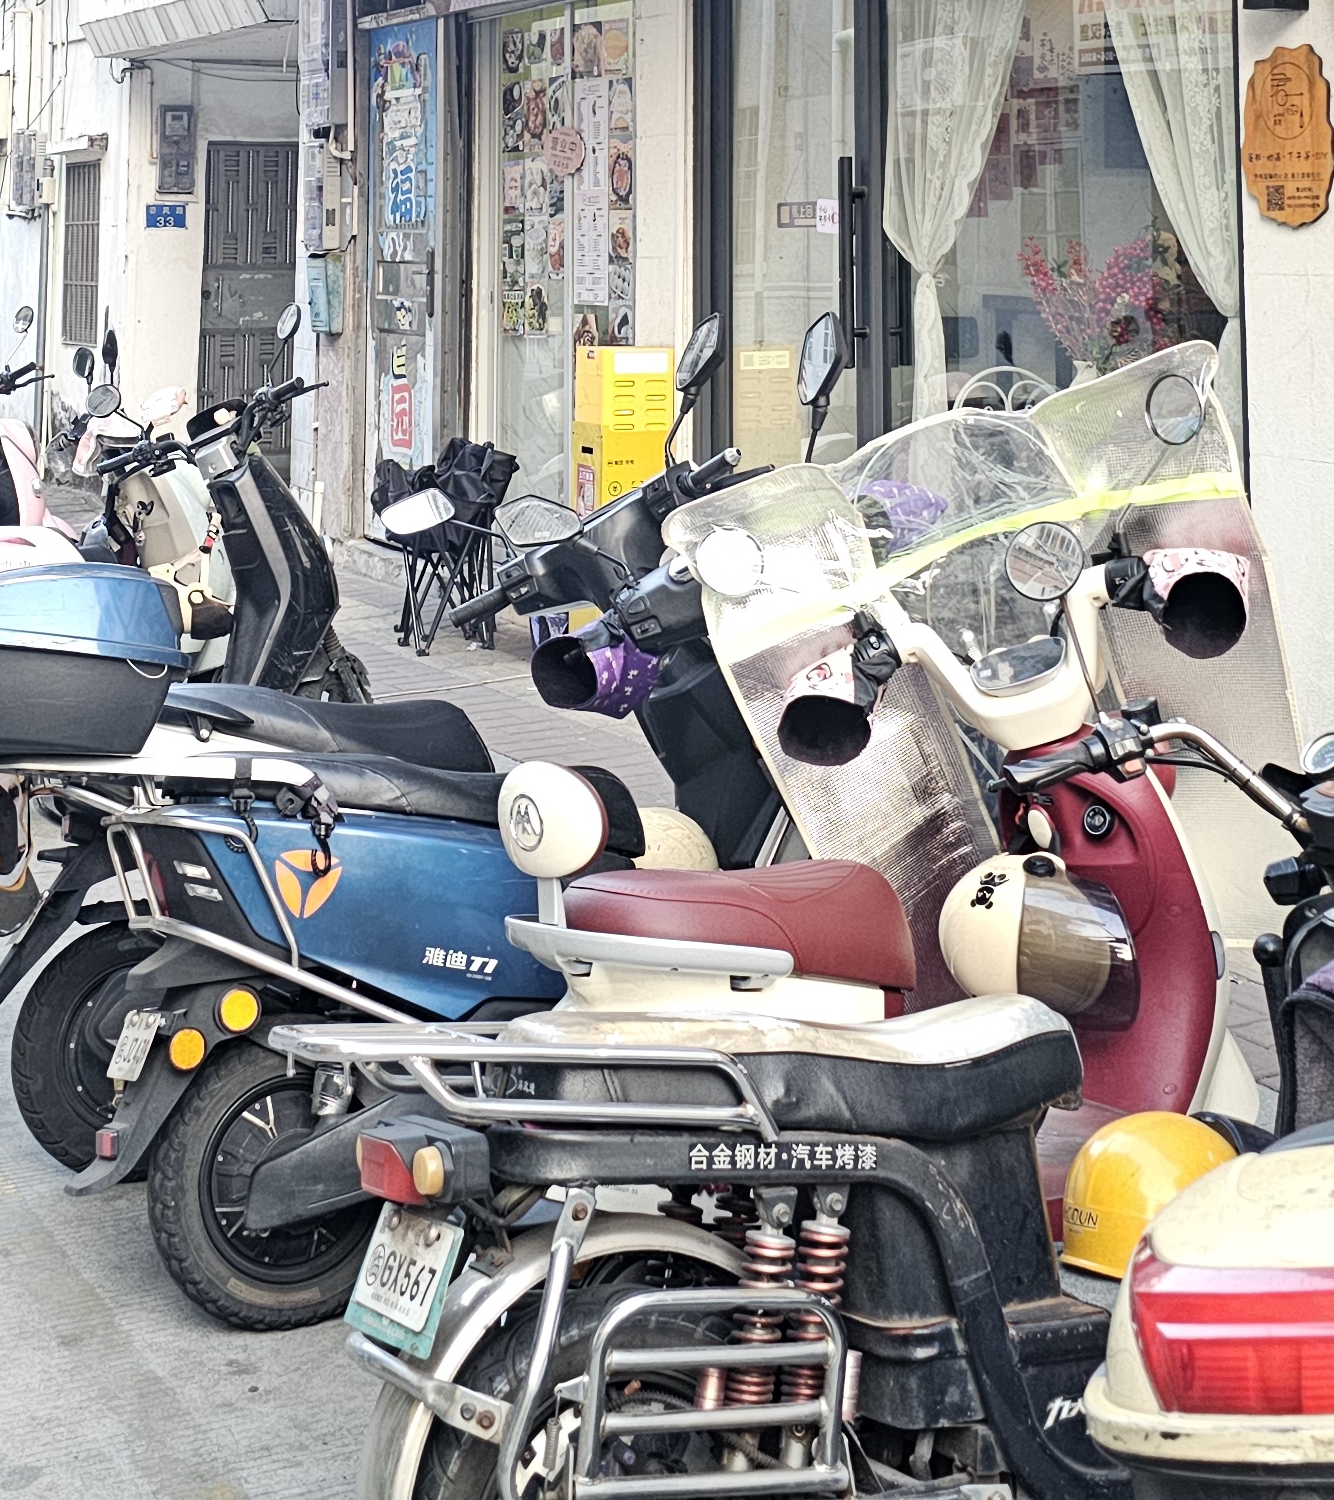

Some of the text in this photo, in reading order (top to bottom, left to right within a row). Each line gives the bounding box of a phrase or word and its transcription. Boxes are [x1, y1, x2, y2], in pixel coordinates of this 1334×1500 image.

[157, 216, 174, 227] 33
[422, 946, 468, 970] 雅迪
[689, 1143, 877, 1170] 合金钢材·汽车烤漆
[380, 1250, 437, 1307] GX567
